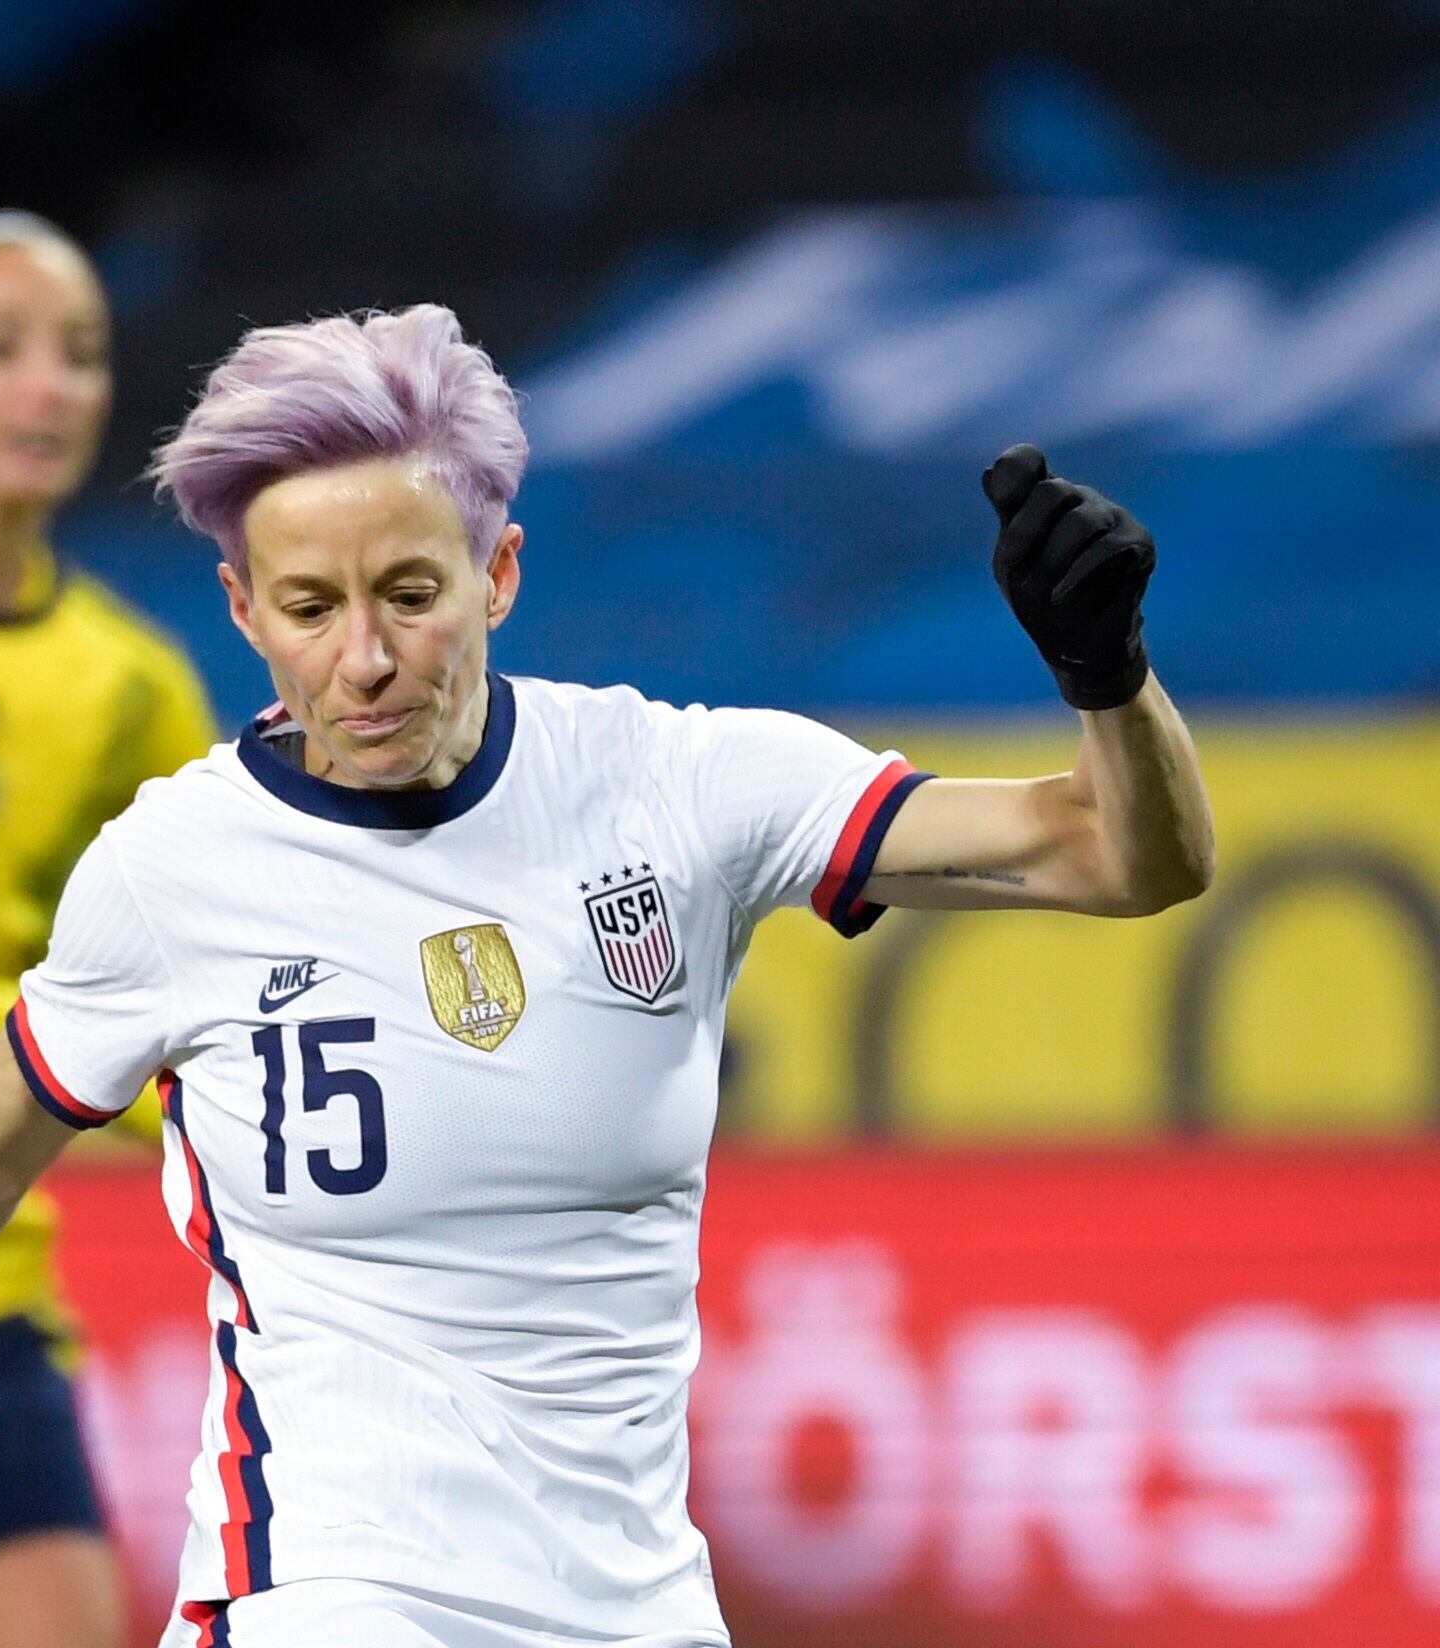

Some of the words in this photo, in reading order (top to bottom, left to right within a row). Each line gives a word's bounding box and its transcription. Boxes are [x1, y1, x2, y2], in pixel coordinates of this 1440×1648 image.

[596, 888, 658, 936] USA
[267, 958, 319, 993] NIKE
[459, 1001, 504, 1024] FIFA
[473, 1024, 500, 1039] 2019
[252, 1016, 388, 1195] 15
[690, 1235, 1440, 1620] ÖRST
